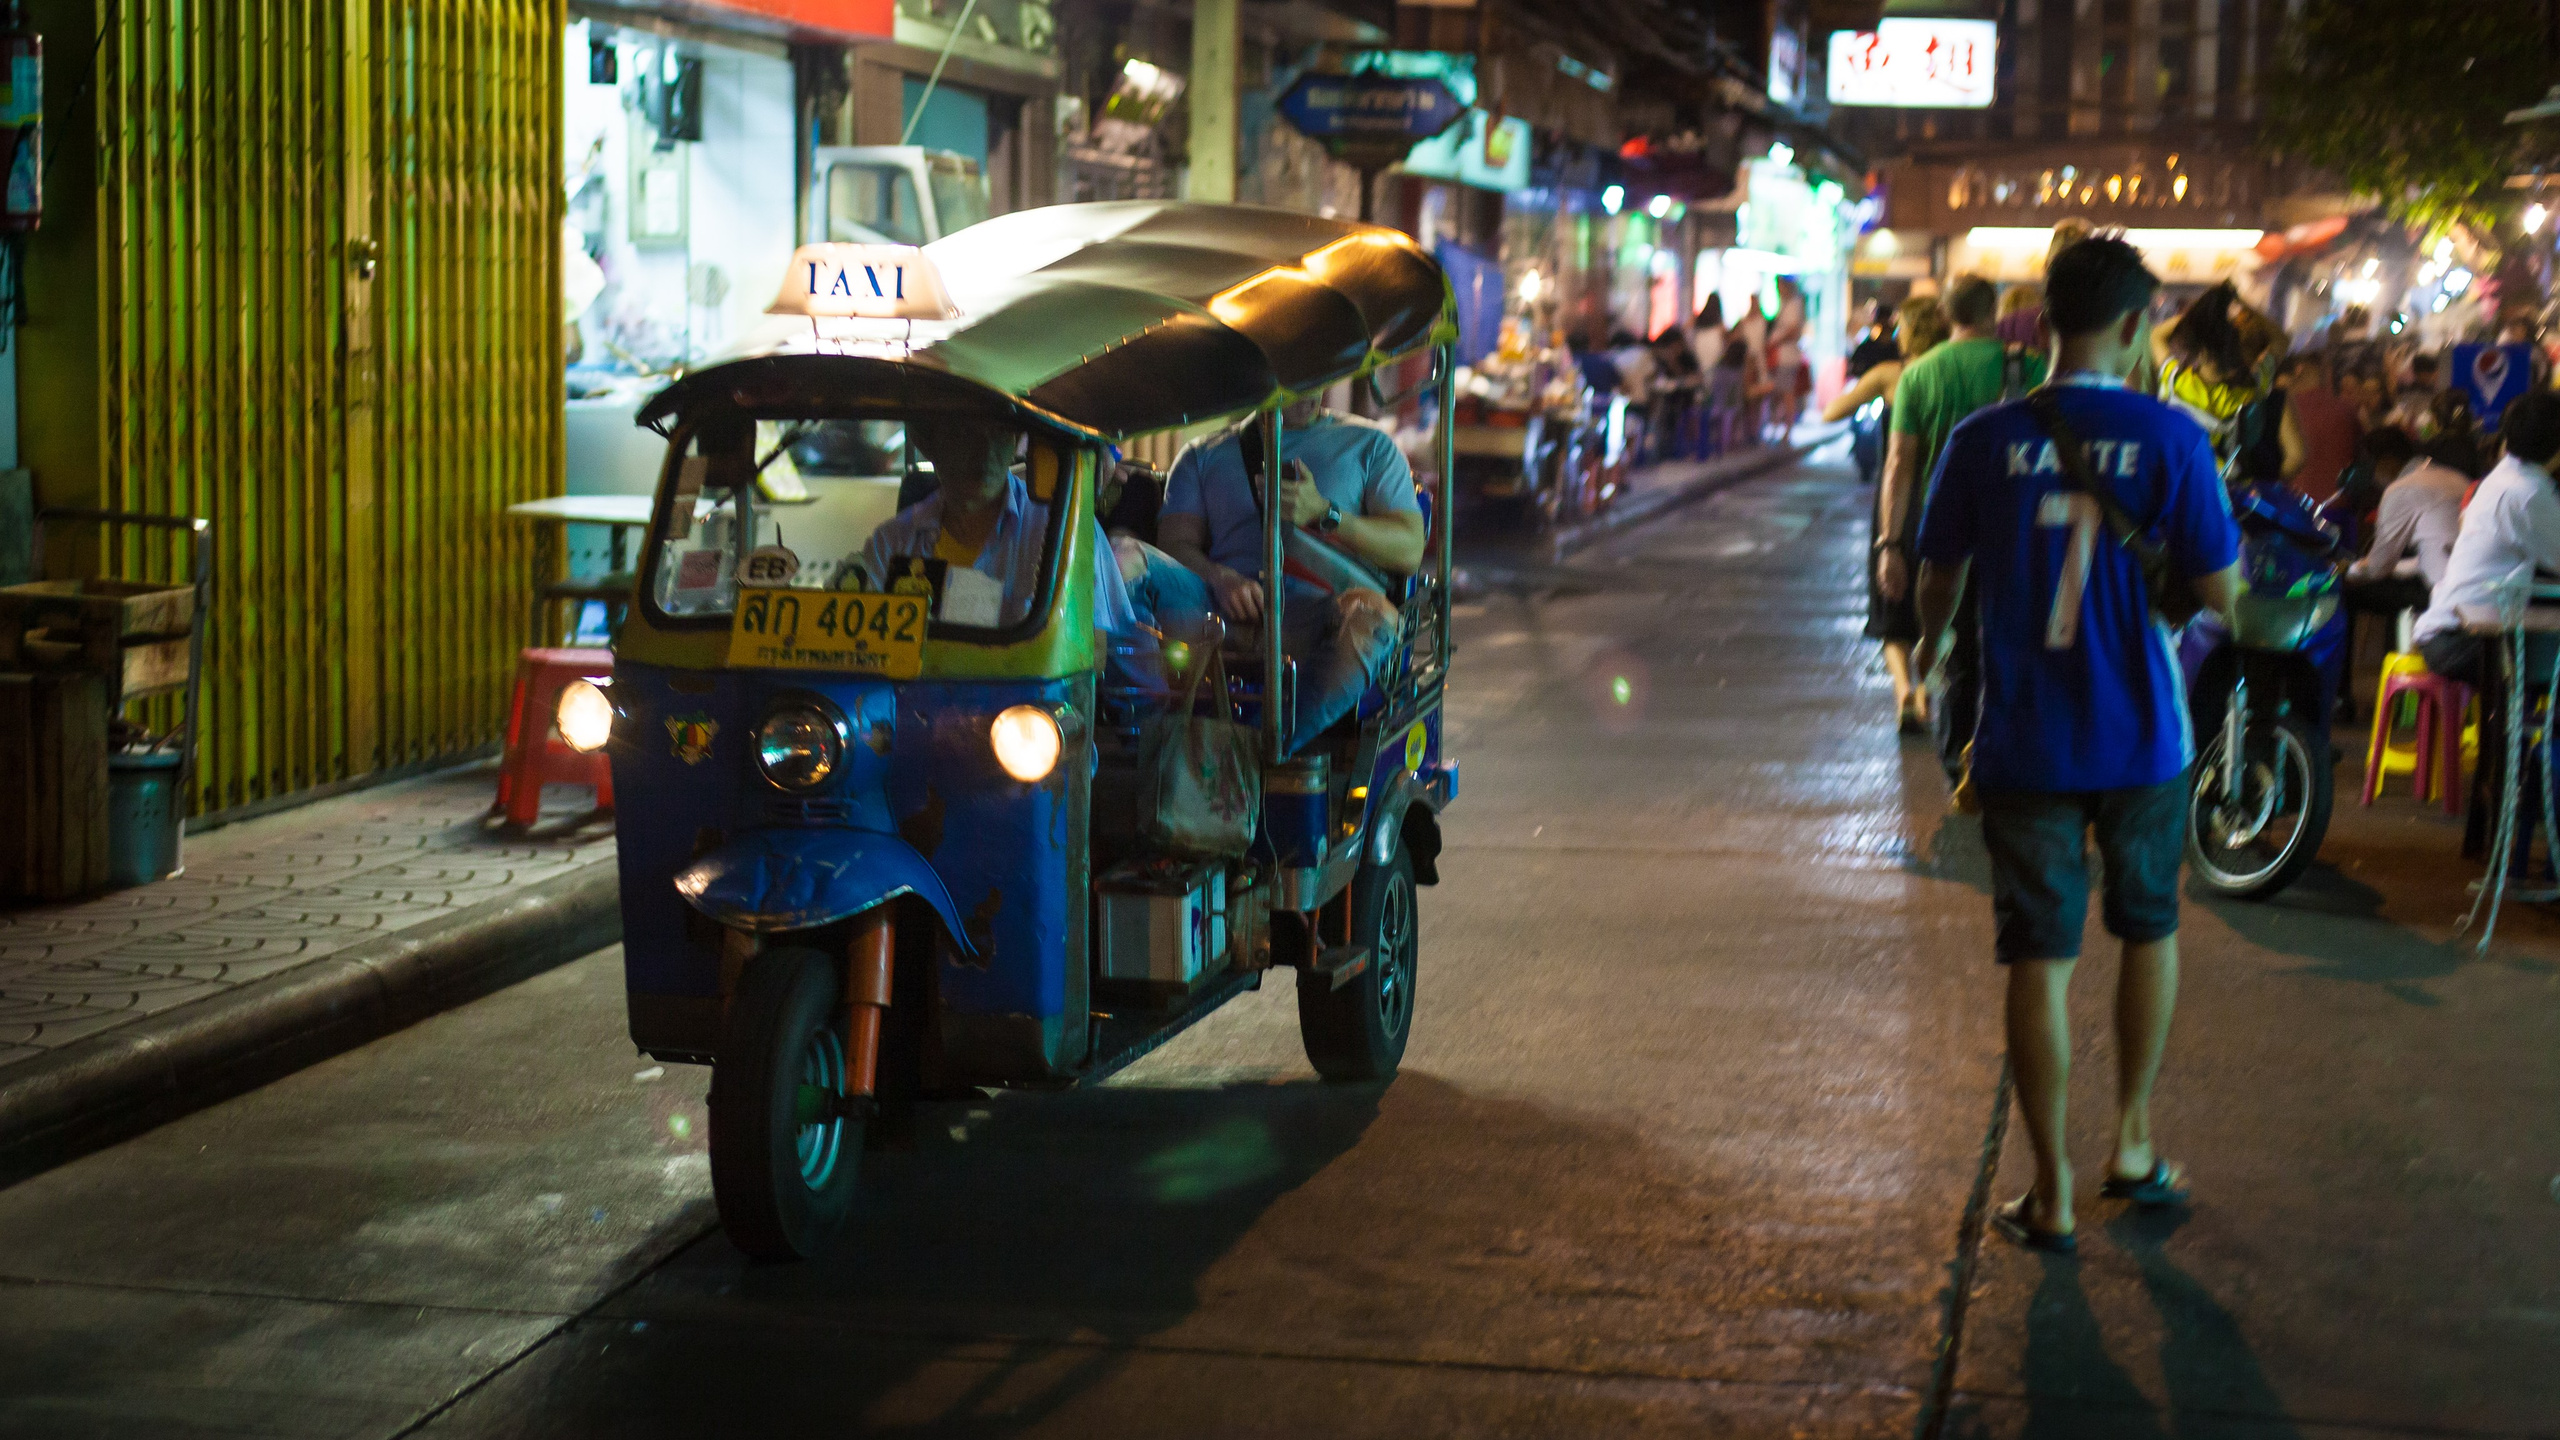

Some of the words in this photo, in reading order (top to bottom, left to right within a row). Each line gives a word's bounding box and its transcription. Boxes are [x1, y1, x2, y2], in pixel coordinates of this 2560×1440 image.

[805, 258, 907, 302] TAXI
[2007, 438, 2141, 478] KATE
[2035, 491, 2102, 651] 7
[816, 598, 919, 643] 4042
